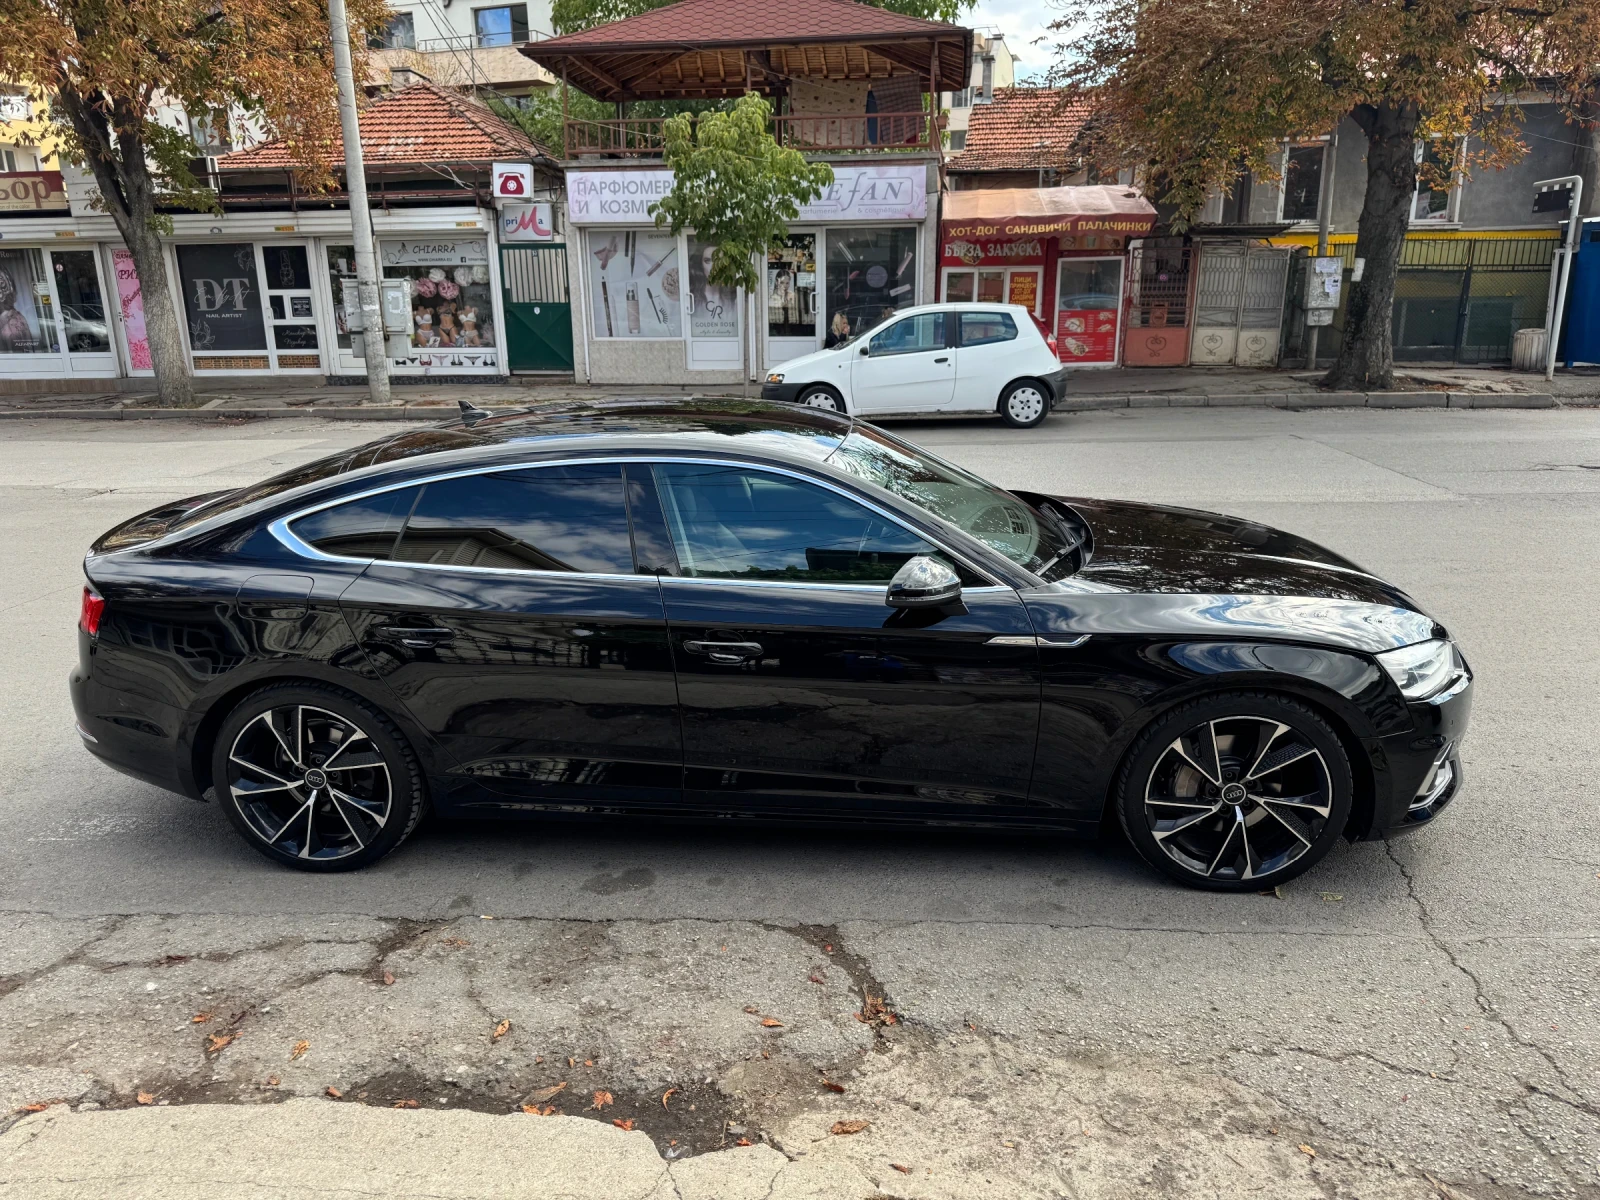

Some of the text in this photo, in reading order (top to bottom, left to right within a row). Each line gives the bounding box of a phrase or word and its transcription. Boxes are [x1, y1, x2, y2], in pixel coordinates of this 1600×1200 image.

[578, 199, 659, 214] И КОЗМ
[949, 221, 1151, 237] ХОТ-ДОГ САНДВИЧИ ПАЛАЧИНКИ
[412, 245, 456, 254] CHIARRA
[987, 243, 1042, 256] ЗАКУСКА
[192, 278, 250, 311] DT
